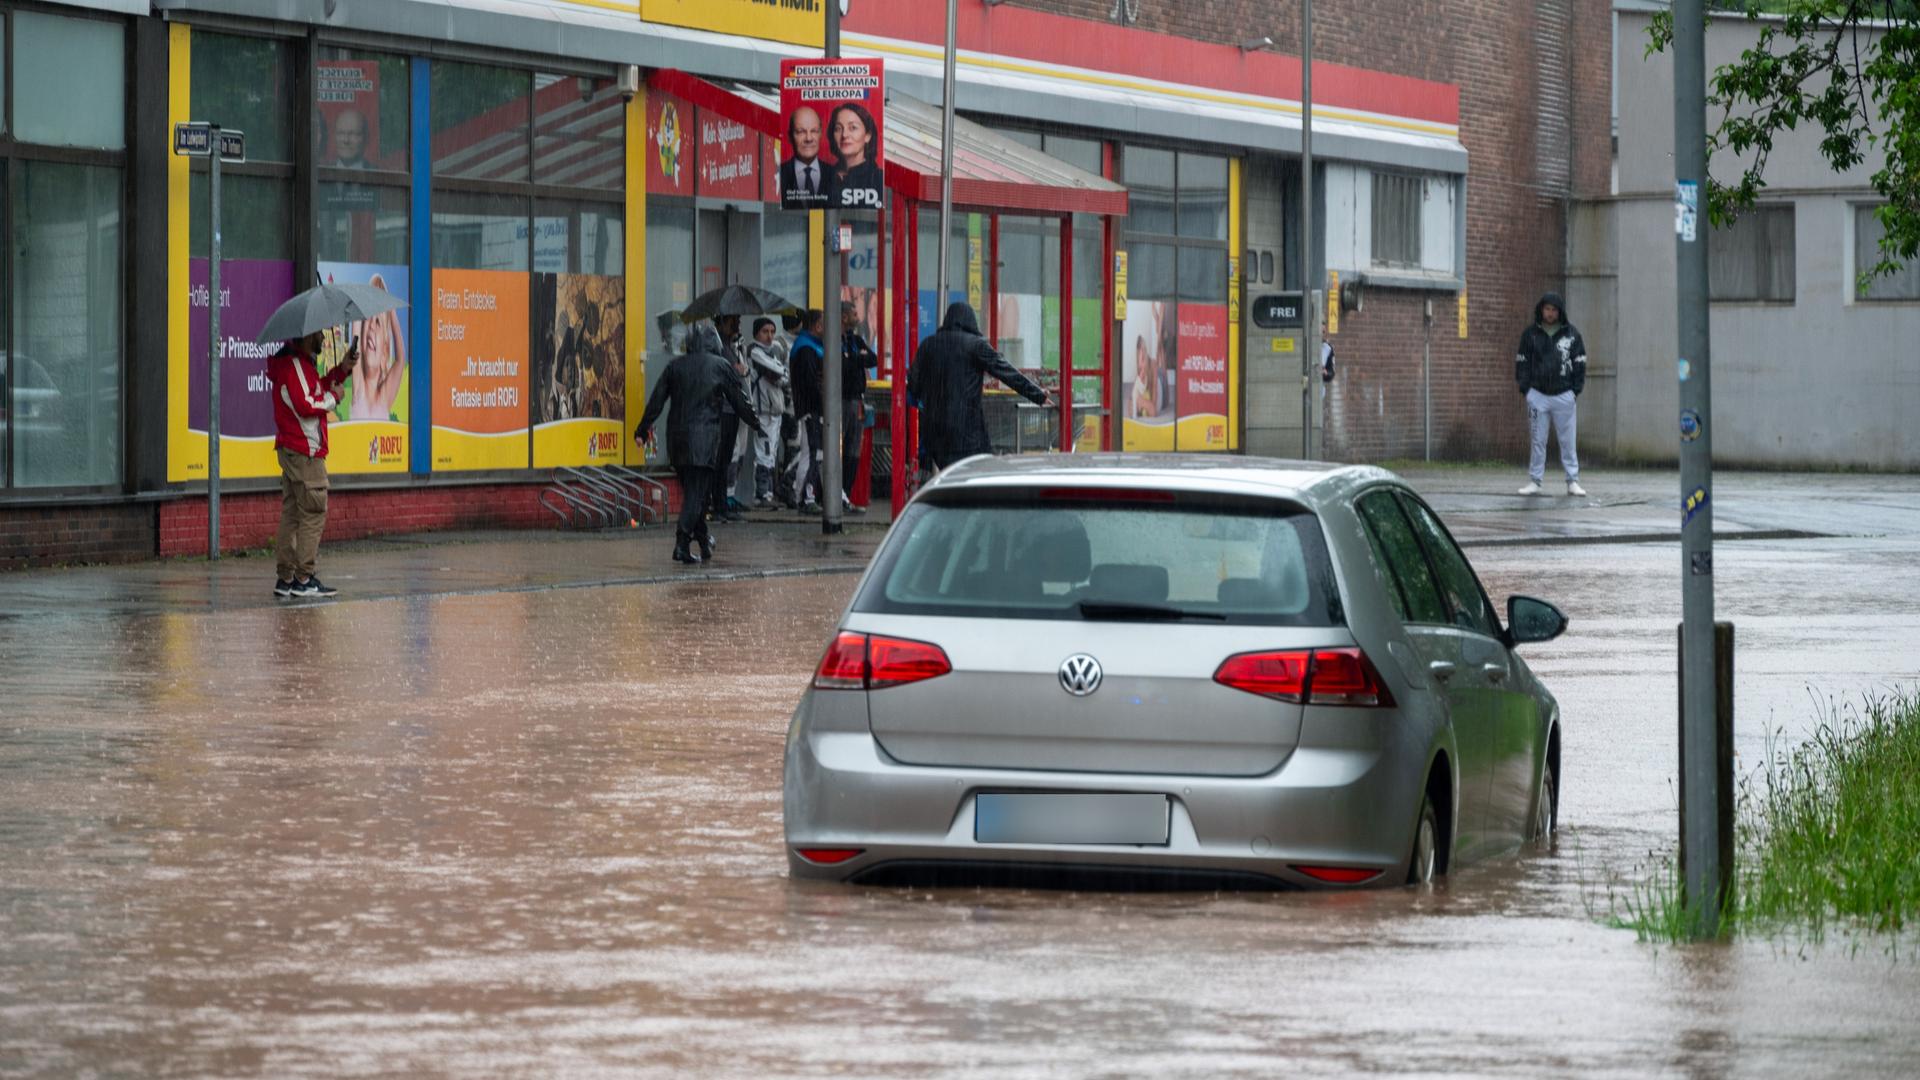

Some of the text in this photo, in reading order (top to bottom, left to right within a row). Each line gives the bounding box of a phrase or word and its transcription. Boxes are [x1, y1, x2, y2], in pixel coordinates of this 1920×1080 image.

[796, 66, 868, 76] DEUTSCHLANDS
[831, 77, 877, 86] STIMMEN
[802, 88, 862, 99] FÜR EUROPA
[1270, 307, 1296, 318] FREI
[437, 319, 466, 341] Eroberer
[461, 356, 518, 377] ...Ihr braucht nur
[247, 370, 264, 392] und
[451, 387, 518, 408] Fantasie und ROFU
[380, 435, 402, 455] ROFU
[598, 432, 618, 450] ROFU
